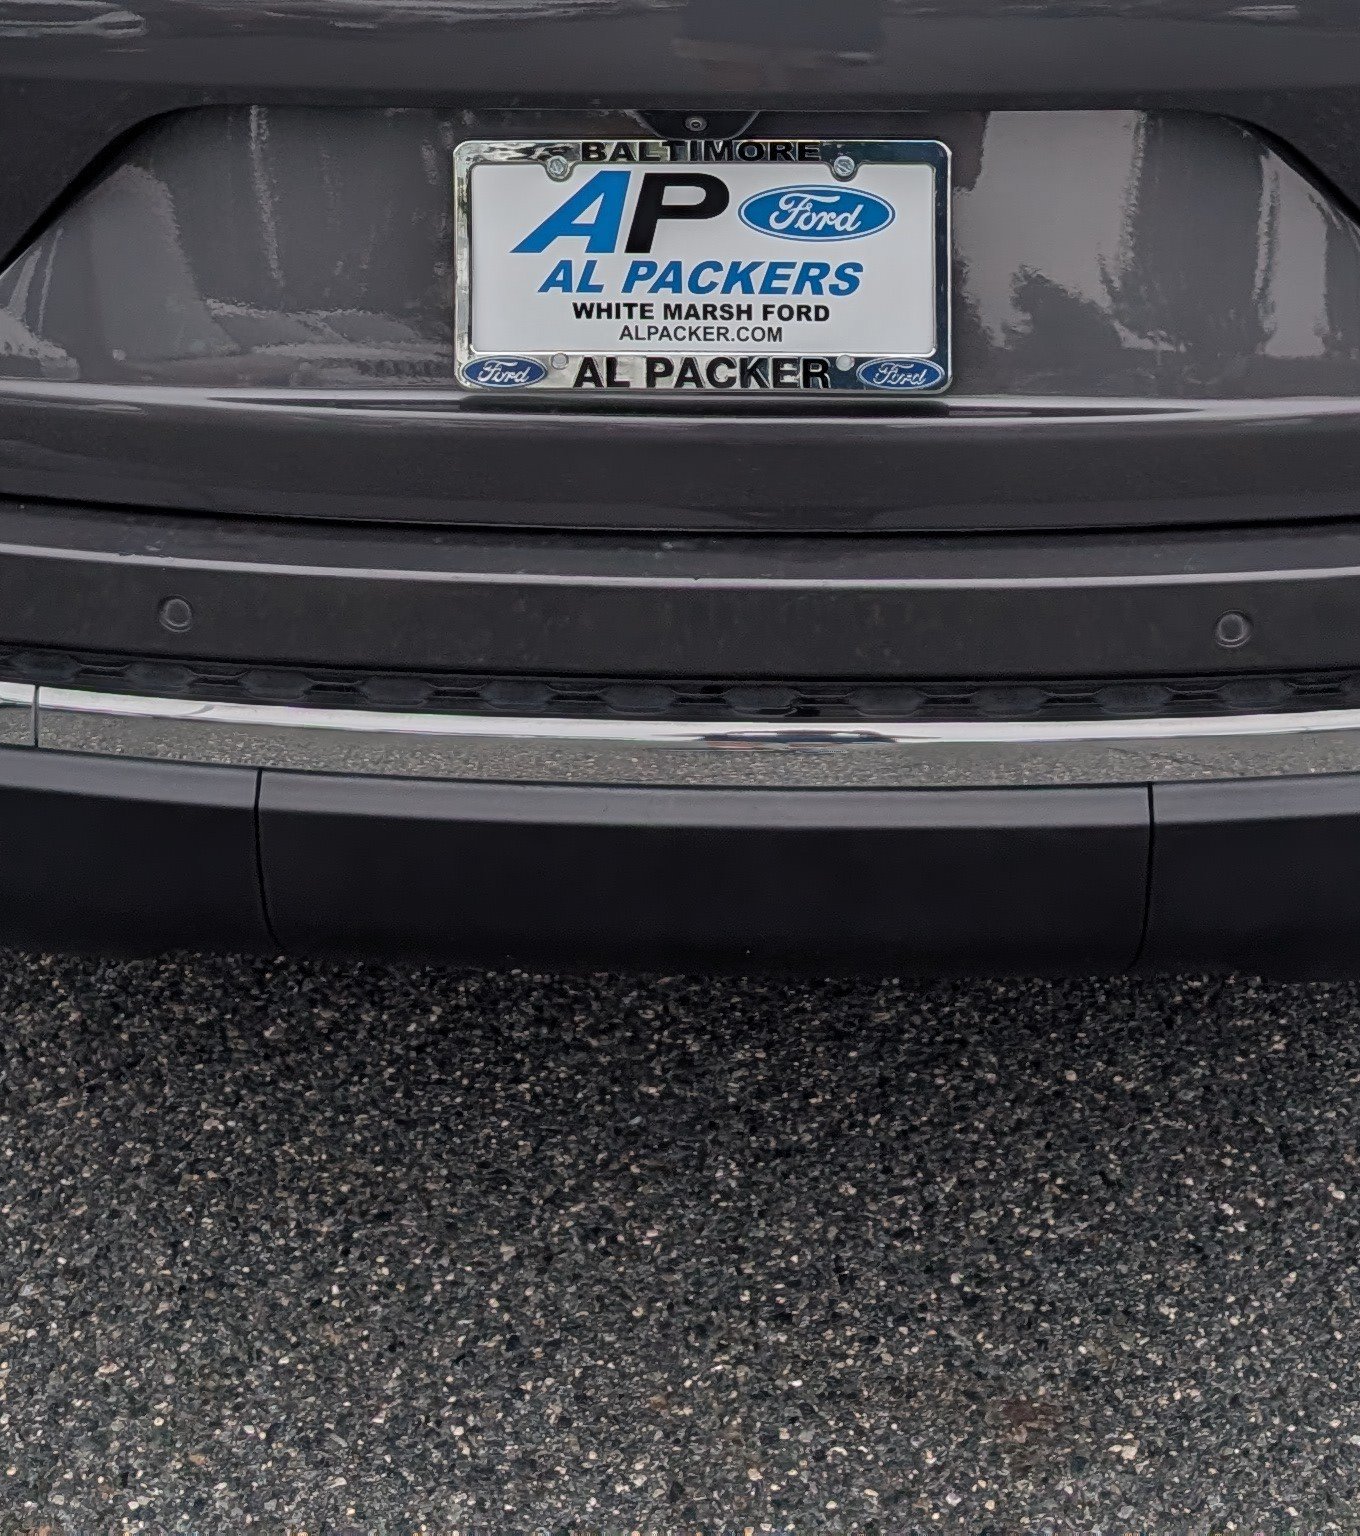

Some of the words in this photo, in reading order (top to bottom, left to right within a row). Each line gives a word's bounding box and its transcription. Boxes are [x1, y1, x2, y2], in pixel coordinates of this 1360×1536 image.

[581, 141, 821, 162] BALTIMORE
[509, 170, 730, 254] AP
[768, 192, 862, 233] Ford
[538, 260, 604, 293] AL
[621, 260, 864, 296] PACKERS
[572, 303, 654, 320] WHITE
[663, 304, 753, 321] MARSH
[762, 305, 830, 321] FORD
[619, 325, 783, 342] ALPACKER.COM
[477, 359, 532, 383] Ford
[573, 357, 630, 388] AL
[646, 357, 831, 389] PACKER
[873, 362, 928, 385] Ford
